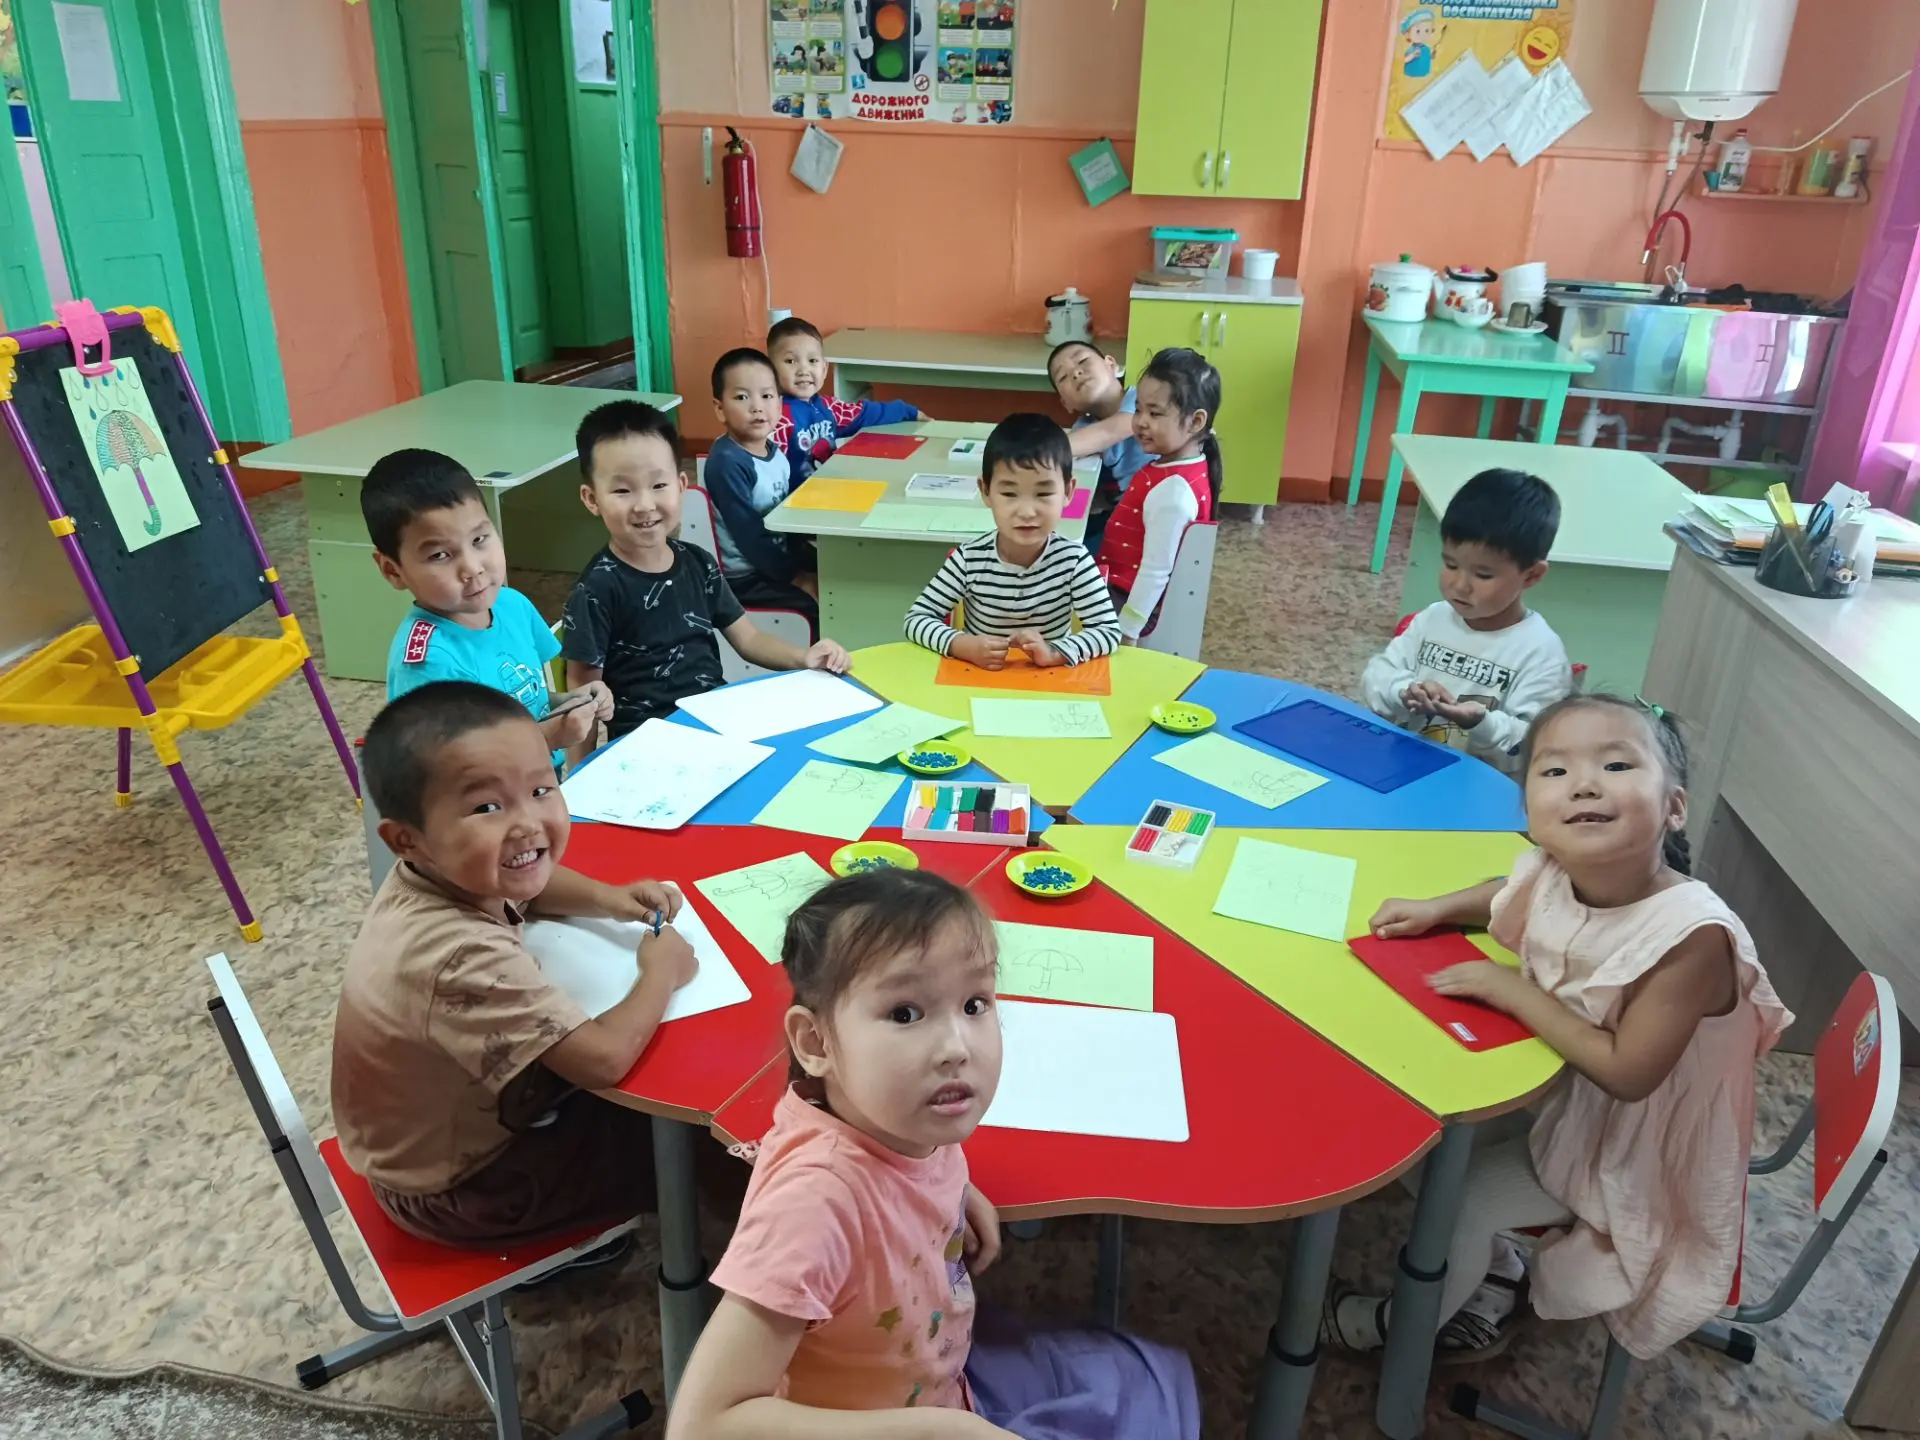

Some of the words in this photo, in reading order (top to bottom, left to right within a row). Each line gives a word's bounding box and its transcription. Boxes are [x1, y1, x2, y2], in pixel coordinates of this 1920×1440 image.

[1443, 5, 1532, 19] ВОСПИТАТЕЛЯ
[852, 92, 929, 107] ДОРОЖНОГО
[857, 107, 924, 120] ДВИЖЕНИЯ
